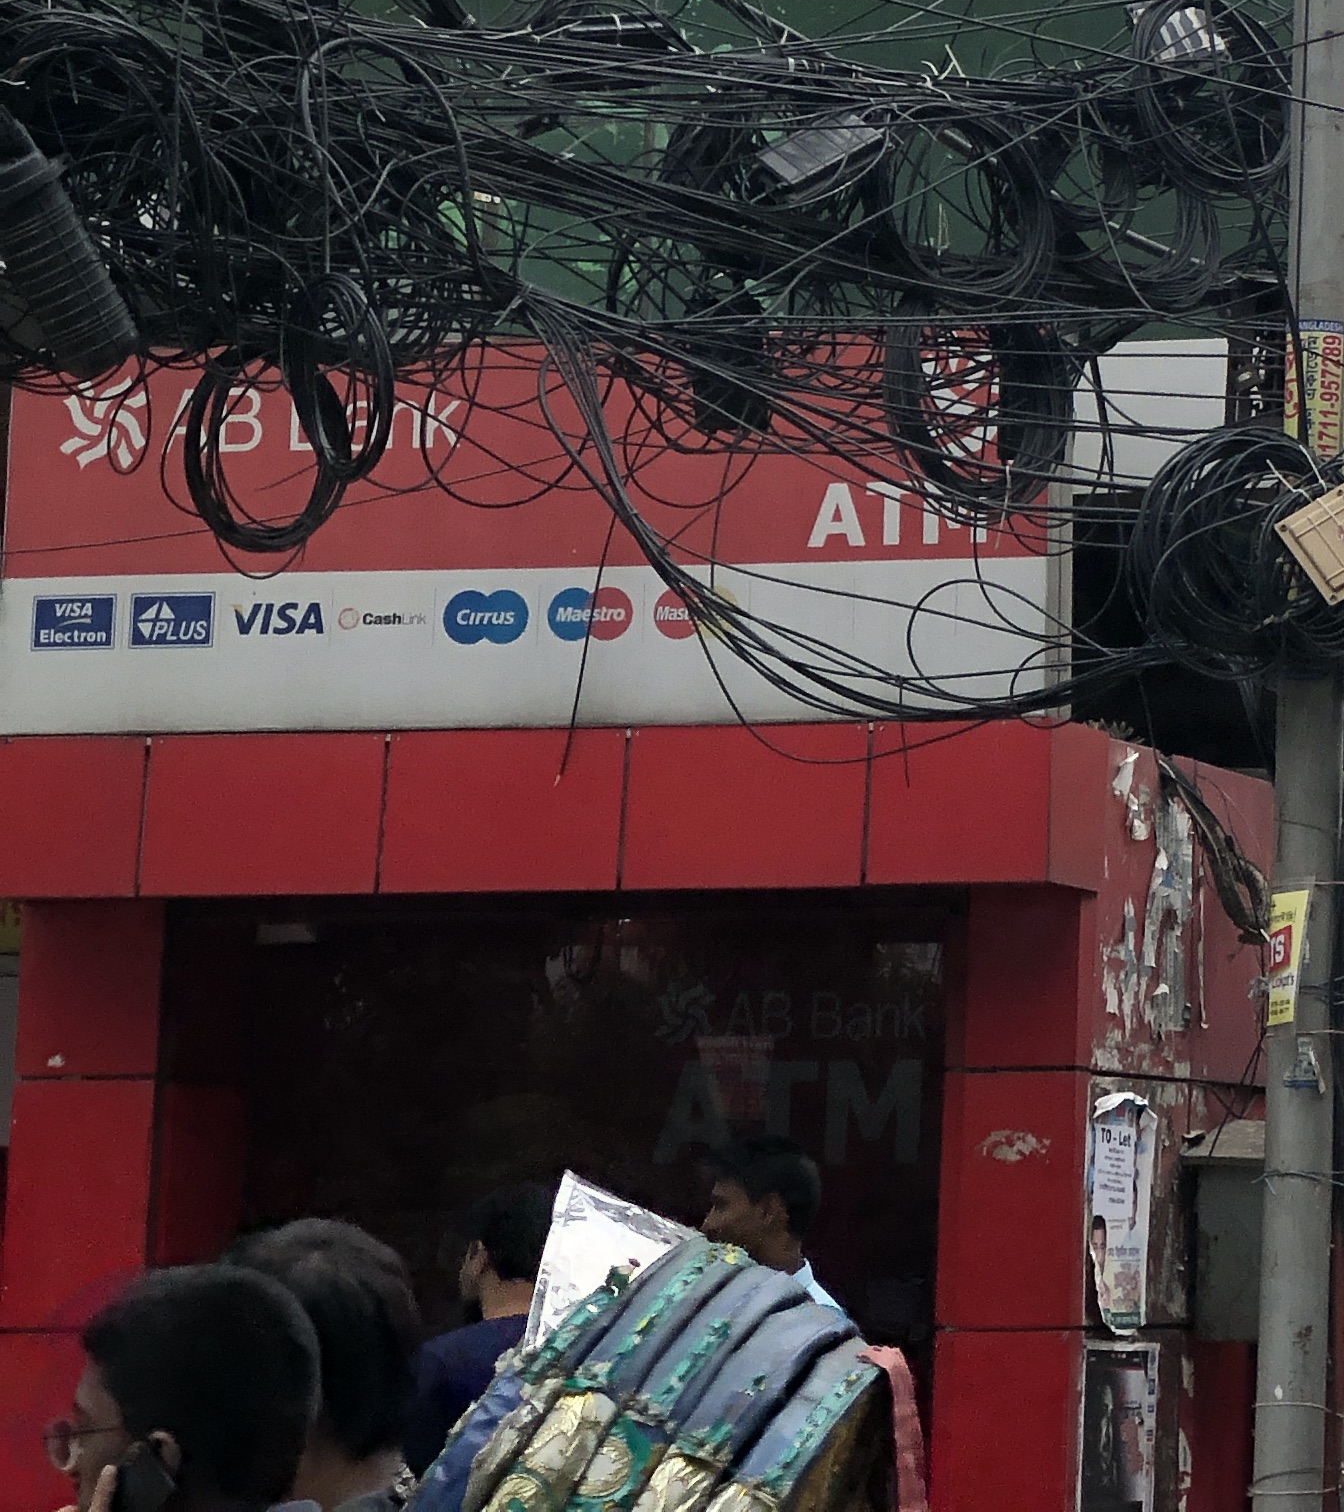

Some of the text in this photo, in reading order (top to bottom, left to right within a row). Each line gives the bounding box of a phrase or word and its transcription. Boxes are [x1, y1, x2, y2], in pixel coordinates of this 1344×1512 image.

[807, 481, 988, 548] ATM
[54, 602, 93, 617] VISA
[456, 608, 516, 626] Cirrus
[555, 606, 626, 623] Maestro
[231, 602, 325, 636] VISA
[362, 612, 427, 626] CashLink
[39, 628, 107, 644] Electron
[152, 620, 208, 641] PLUS
[651, 1058, 923, 1165] ATM
